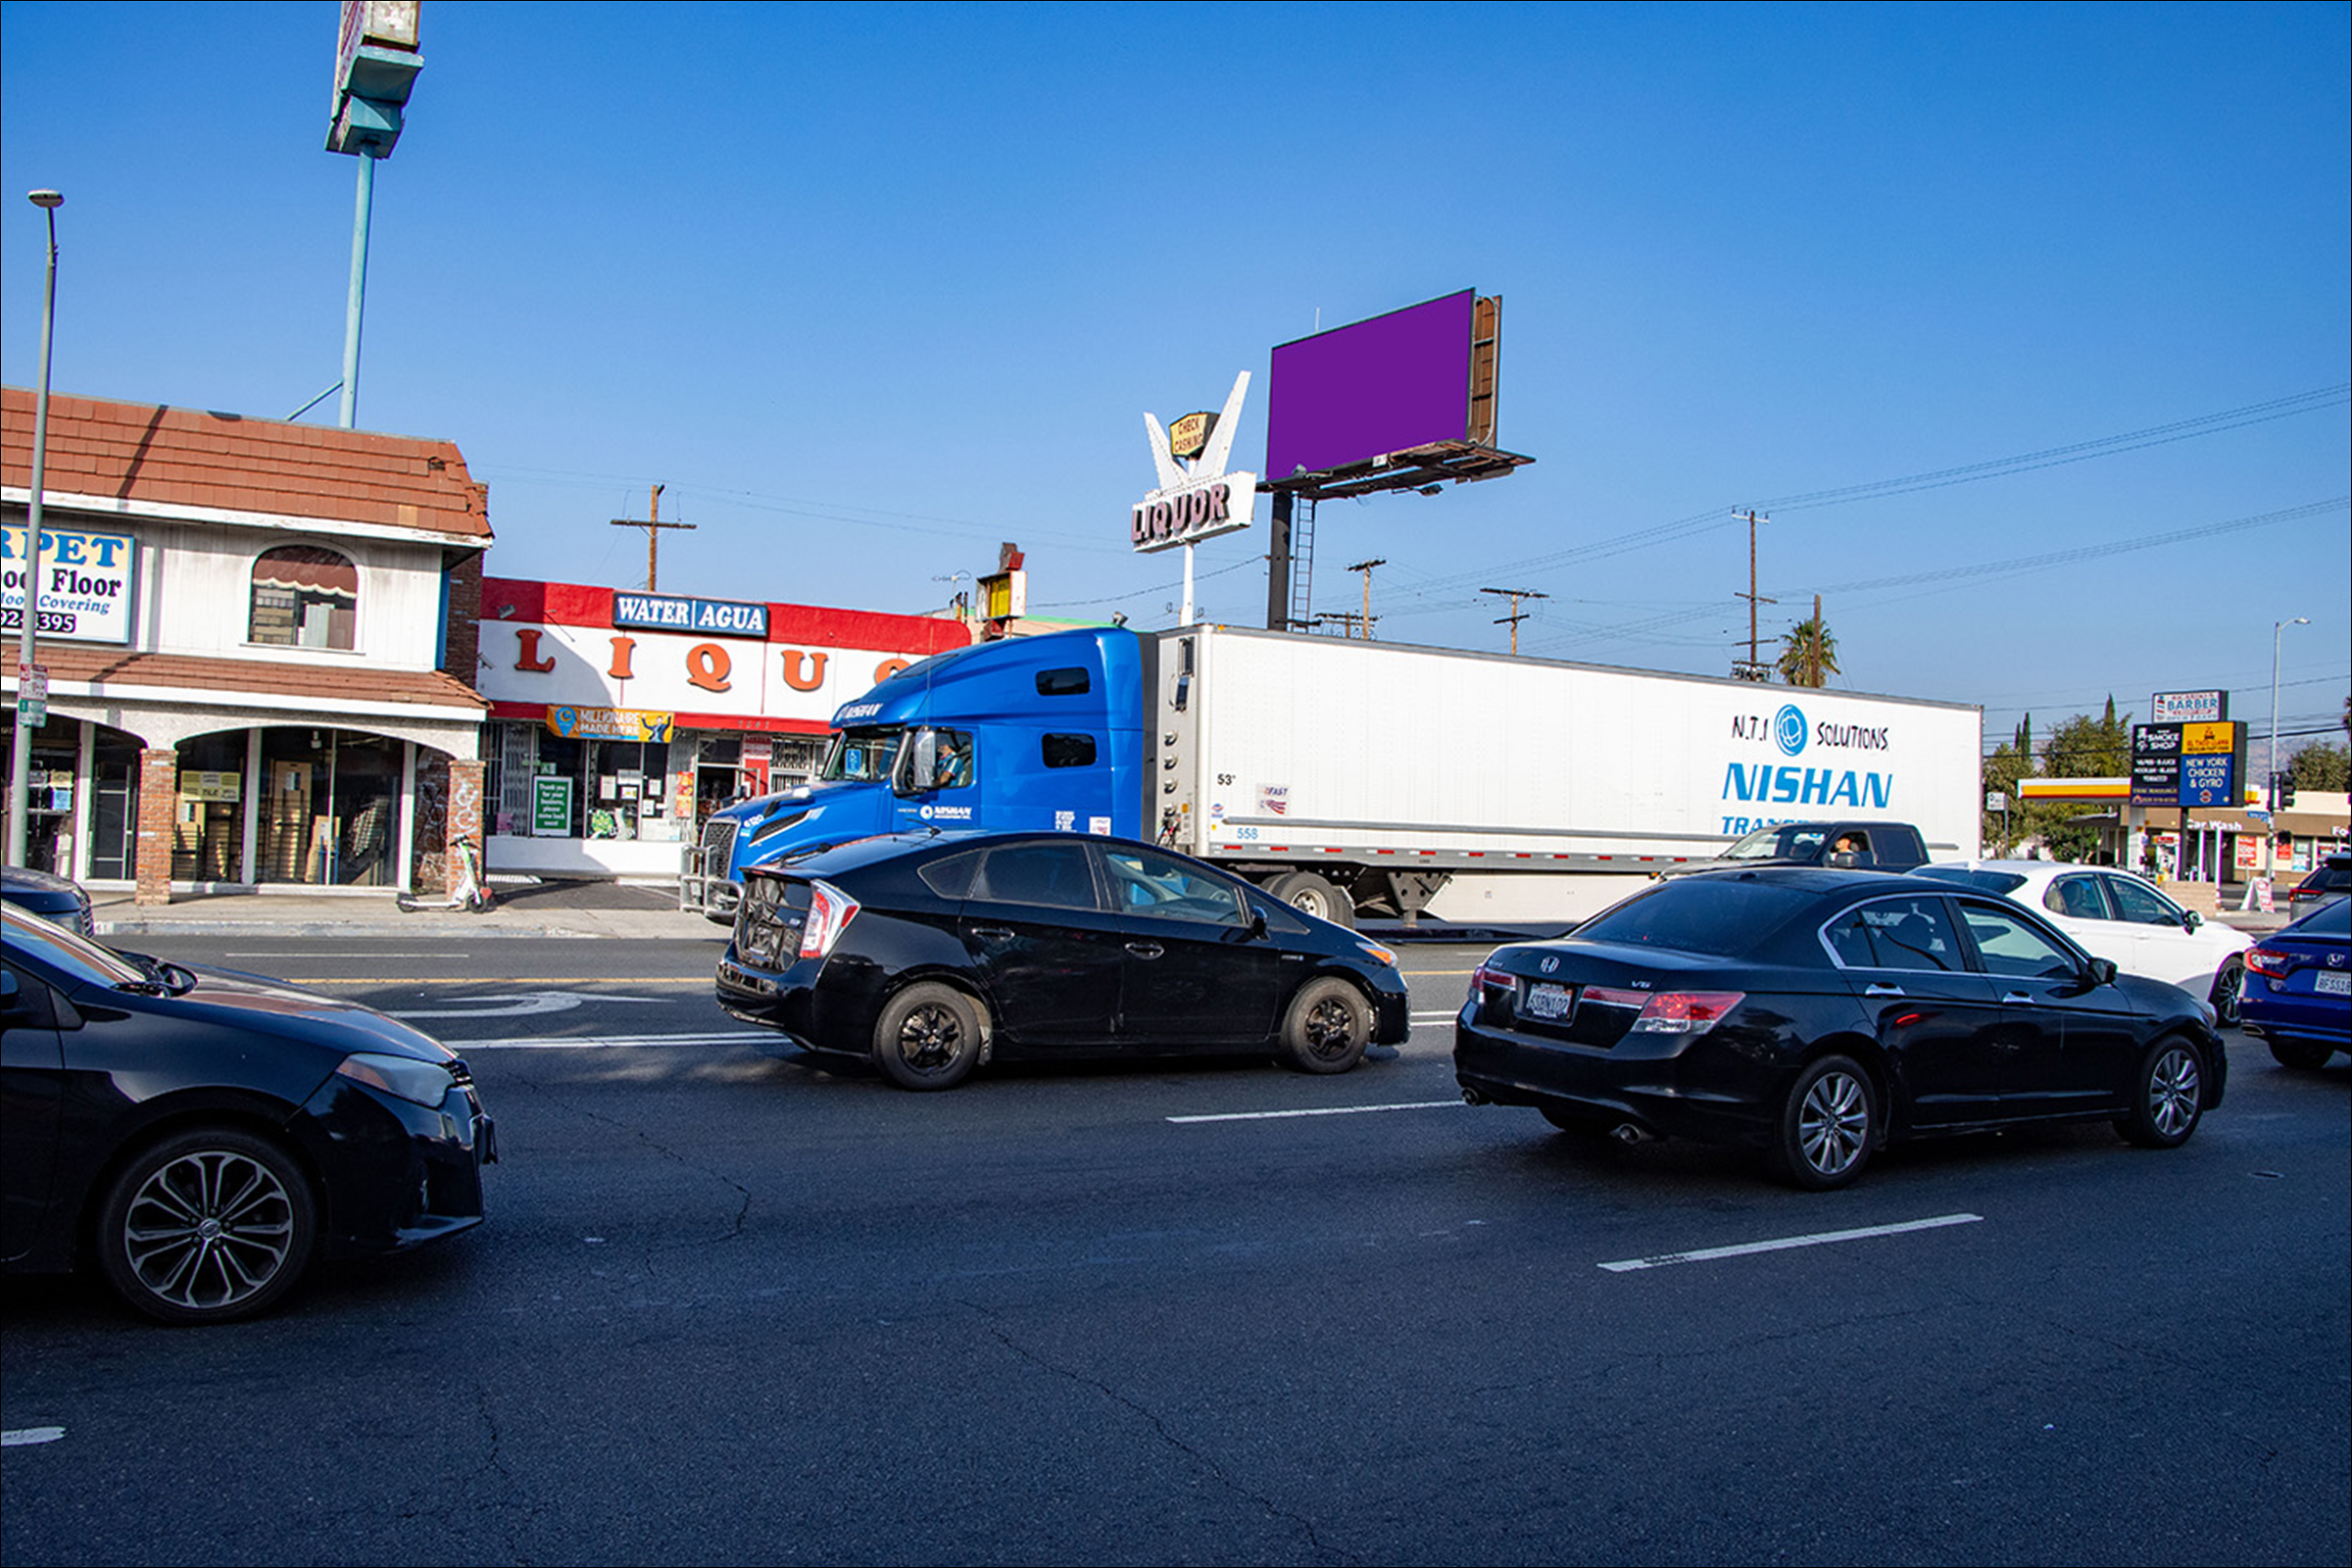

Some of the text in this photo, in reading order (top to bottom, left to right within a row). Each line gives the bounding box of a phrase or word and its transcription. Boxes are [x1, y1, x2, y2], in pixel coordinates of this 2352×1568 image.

[1178, 416, 1200, 435] CHECK
[1174, 432, 1203, 453] CASHING
[1131, 482, 1230, 543] LIQUOR
[51, 568, 122, 597] Floor
[39, 594, 111, 615] Covering
[617, 596, 764, 630] WATER AGUA
[2167, 698, 2219, 710] BARBER
[580, 710, 640, 725] MILLIONAIRE
[580, 723, 640, 736] MADE HERE
[1817, 721, 1889, 751] SOLUTIONS
[2148, 732, 2180, 743] SMOKE
[2150, 742, 2178, 751] SHOP
[2185, 758, 2229, 767] NEW YORK
[2187, 767, 2227, 778] CHICKEN
[1722, 762, 1893, 808] NISHAN
[2189, 777, 2224, 788] & GYRO
[2187, 818, 2243, 832] Car Wash
[1237, 827, 1259, 840] 558
